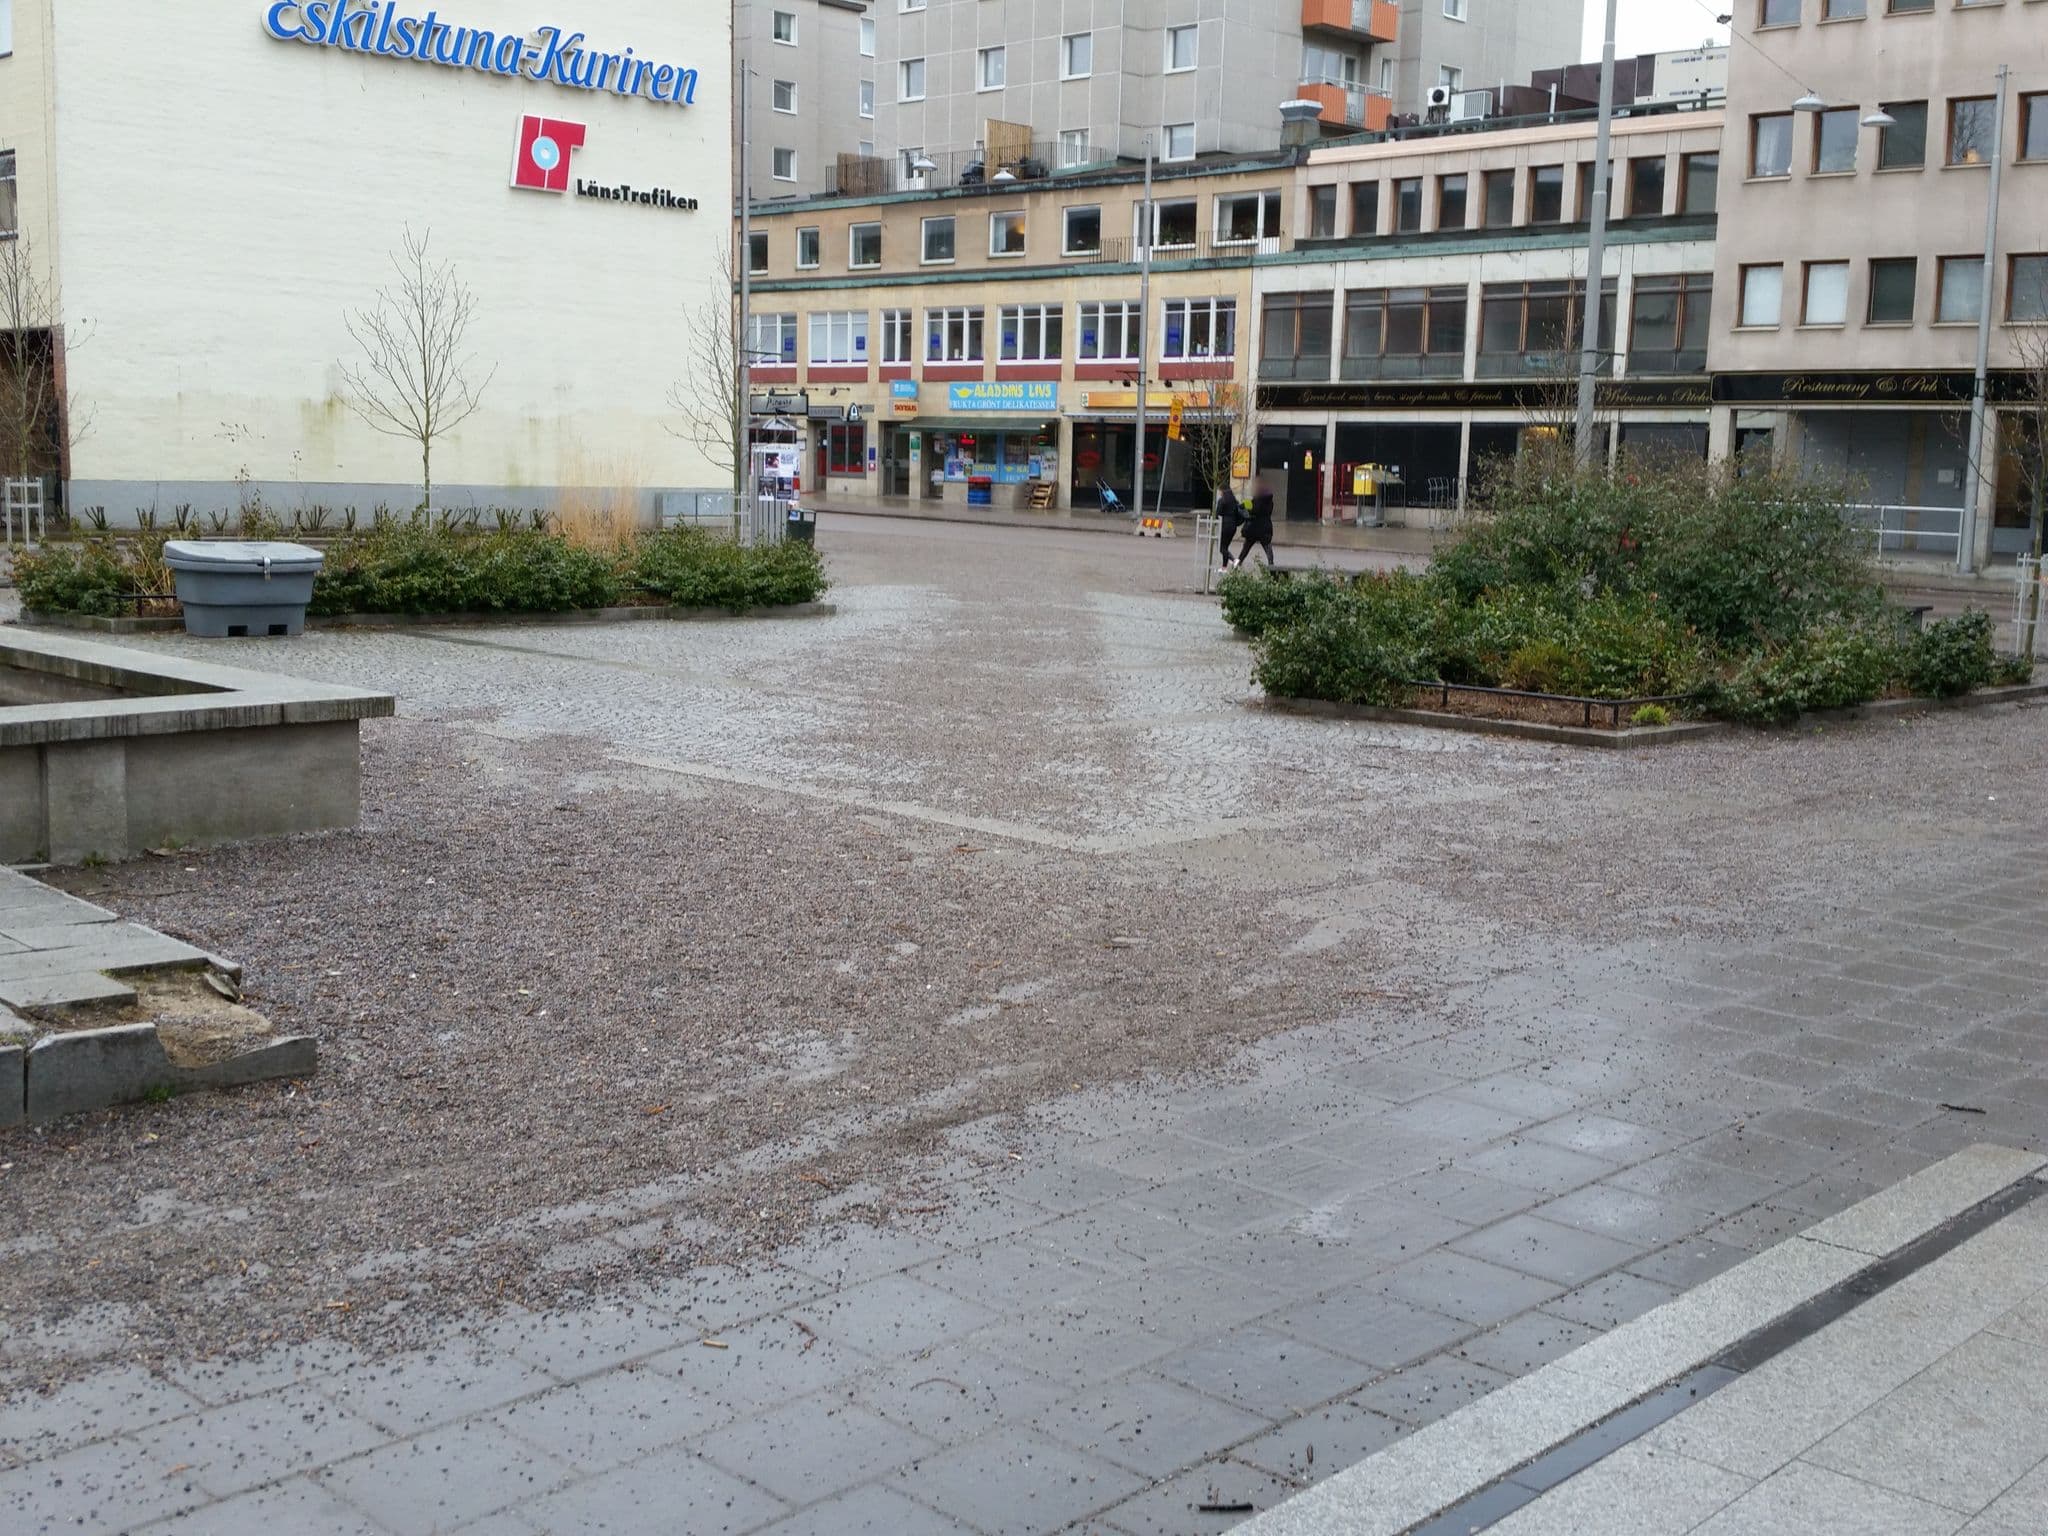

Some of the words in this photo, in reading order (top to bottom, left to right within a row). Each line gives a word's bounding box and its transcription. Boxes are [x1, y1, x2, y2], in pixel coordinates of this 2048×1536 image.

[266, 0, 698, 105] Eskilstuna-Kuriren
[576, 178, 698, 210] LänsTrafiken
[974, 383, 1024, 398] ALADDINS
[1029, 383, 1052, 398] LIVS
[1782, 376, 1870, 399] Restaurang
[1876, 376, 1898, 392] &
[1902, 376, 1938, 392] Pub
